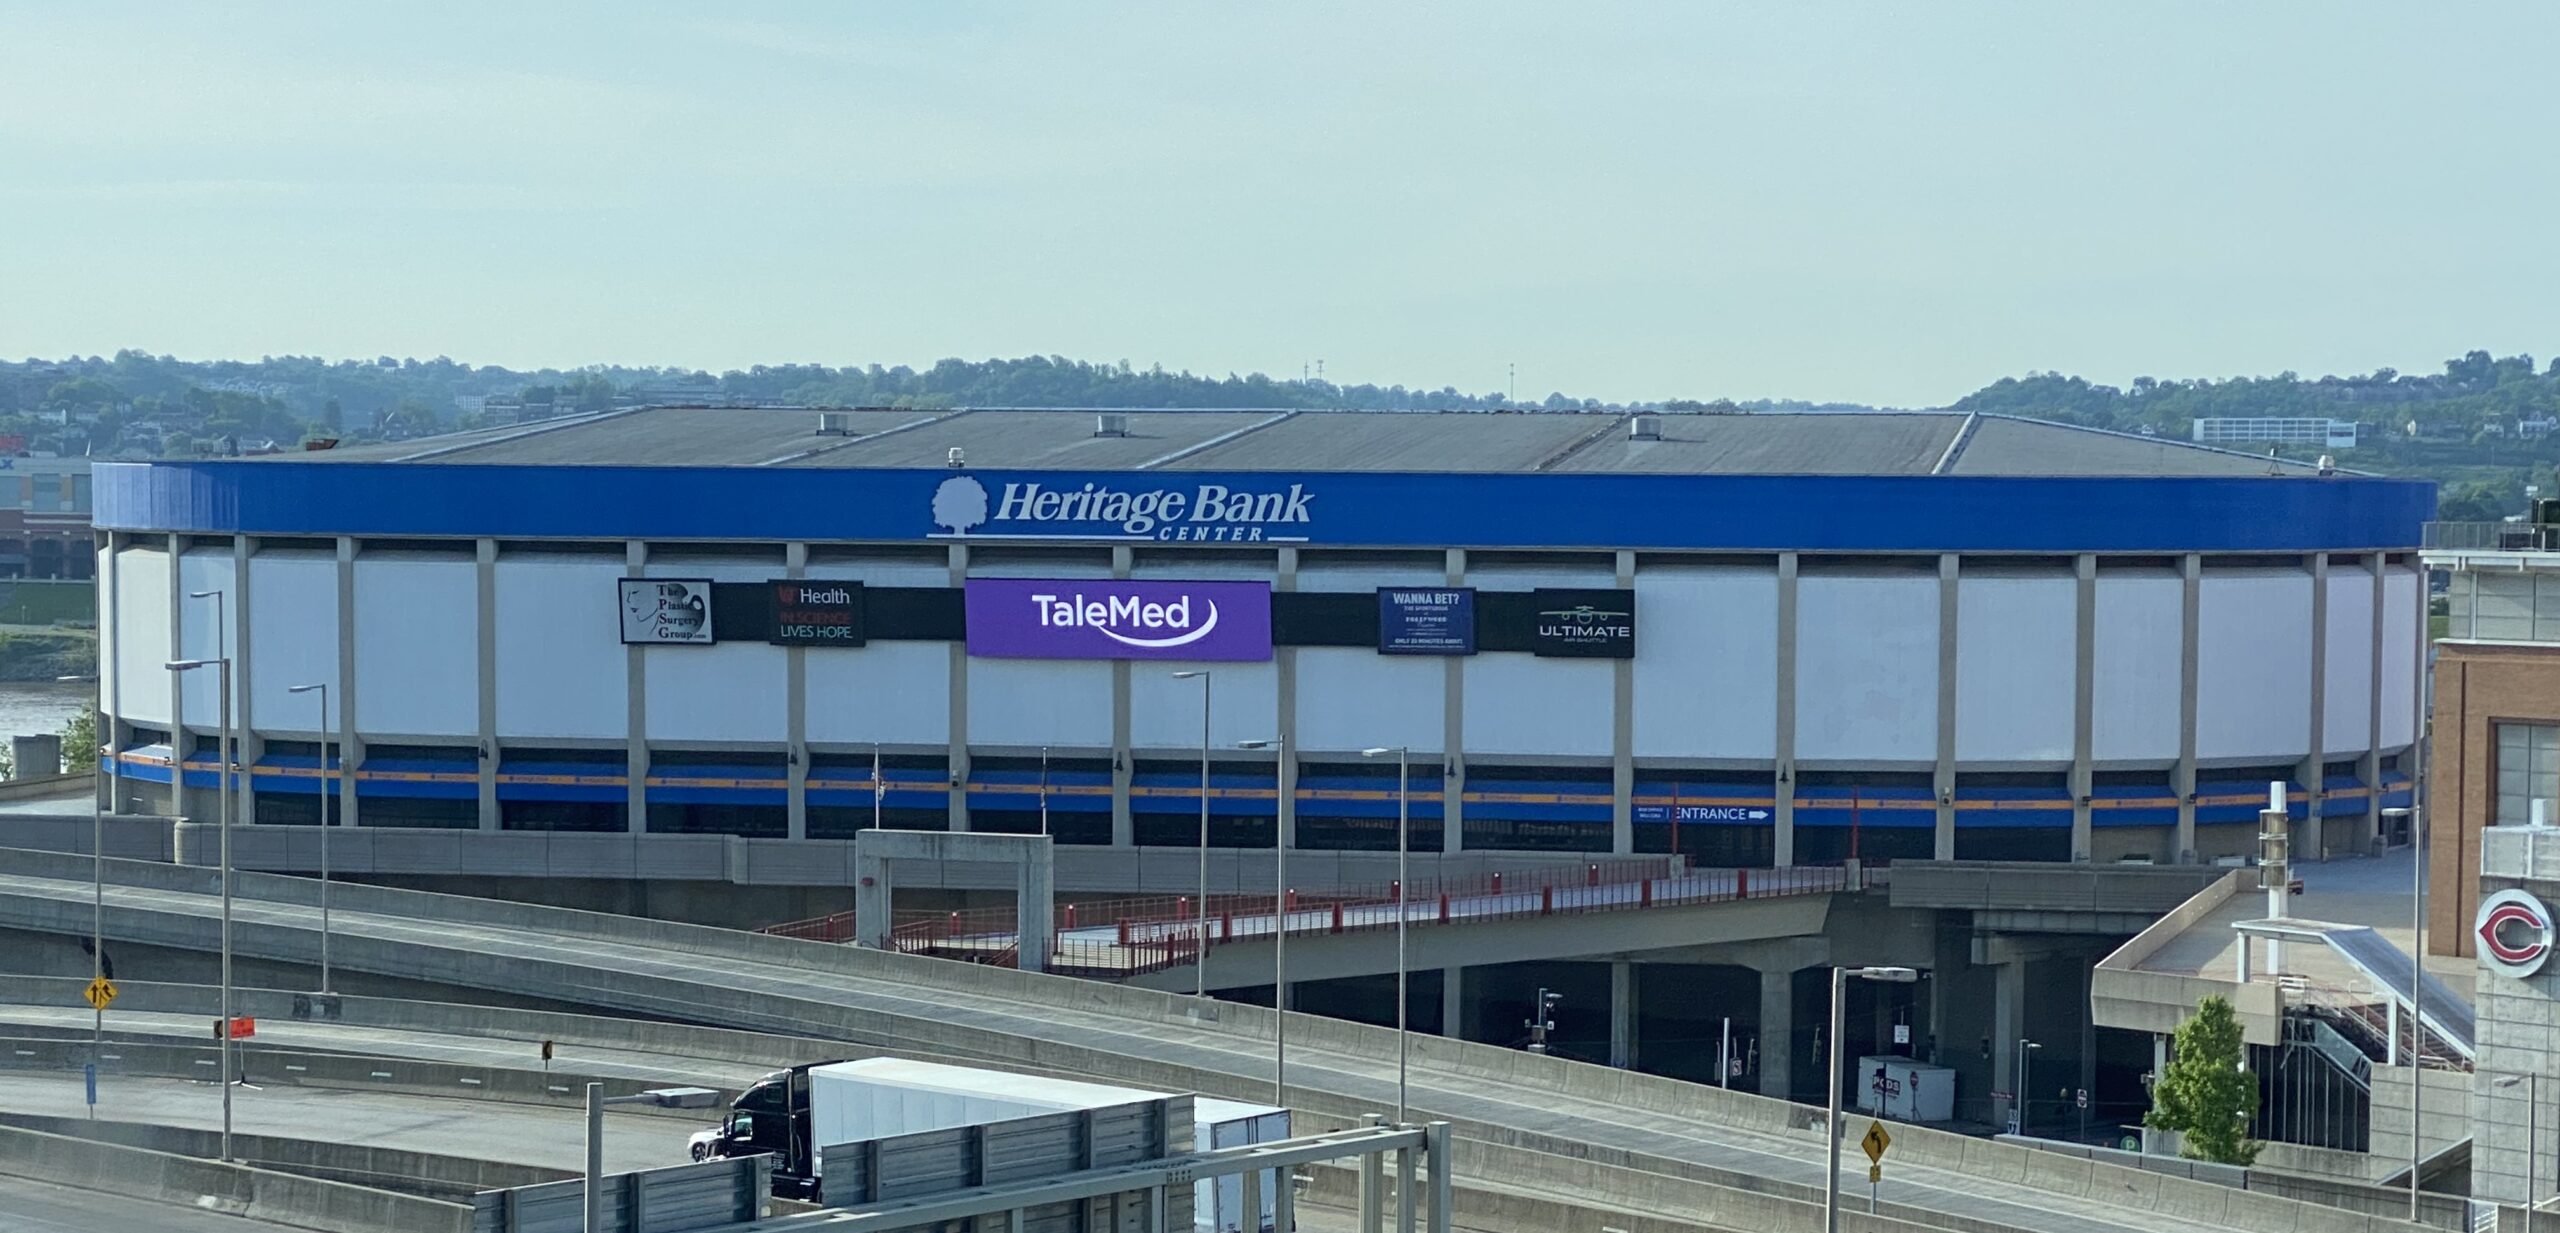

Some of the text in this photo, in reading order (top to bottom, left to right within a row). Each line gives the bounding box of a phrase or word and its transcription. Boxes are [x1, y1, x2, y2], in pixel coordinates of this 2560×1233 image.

[994, 482, 1316, 534] Heritage Bank
[1159, 526, 1266, 542] CENTER
[656, 584, 681, 596] The
[800, 588, 850, 604] Health
[1393, 593, 1460, 605] WANNA BET?
[1031, 594, 1190, 628] TaleMed
[659, 612, 699, 626] Surgery
[780, 625, 853, 639] LIVES HOPE
[1540, 625, 1630, 637] ULTIMATE
[2479, 905, 2544, 963] C
